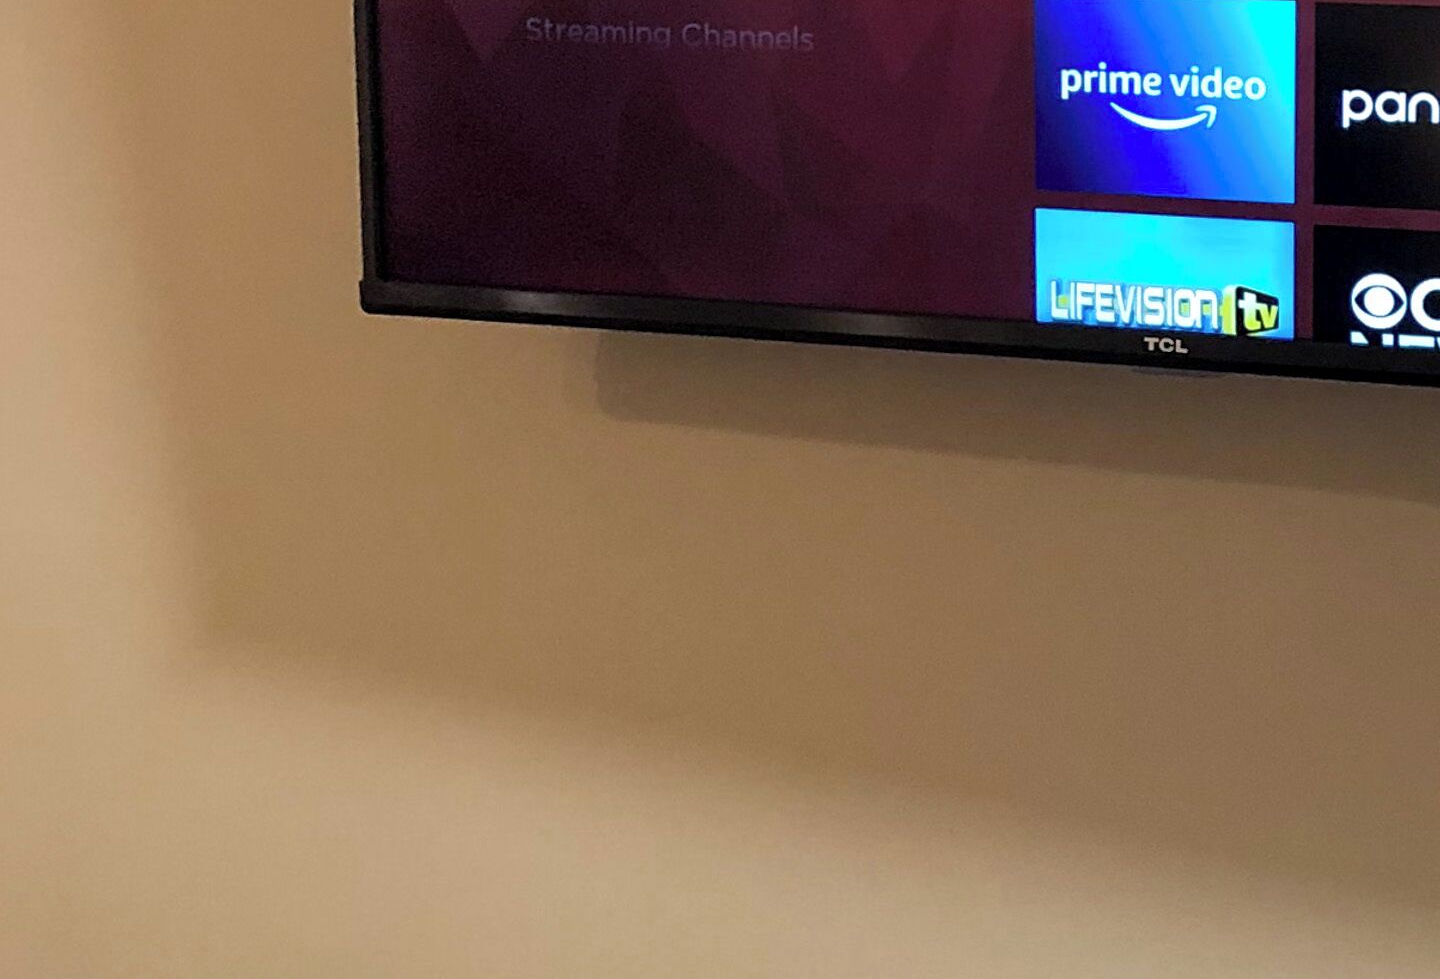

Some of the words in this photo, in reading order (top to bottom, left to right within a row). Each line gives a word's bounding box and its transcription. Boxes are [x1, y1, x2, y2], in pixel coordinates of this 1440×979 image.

[525, 18, 671, 49] Streaming
[681, 22, 814, 50] Channels
[1060, 61, 1161, 100] prime
[1168, 65, 1267, 101] video
[1238, 291, 1279, 332] tv
[1144, 337, 1188, 354] TCL
